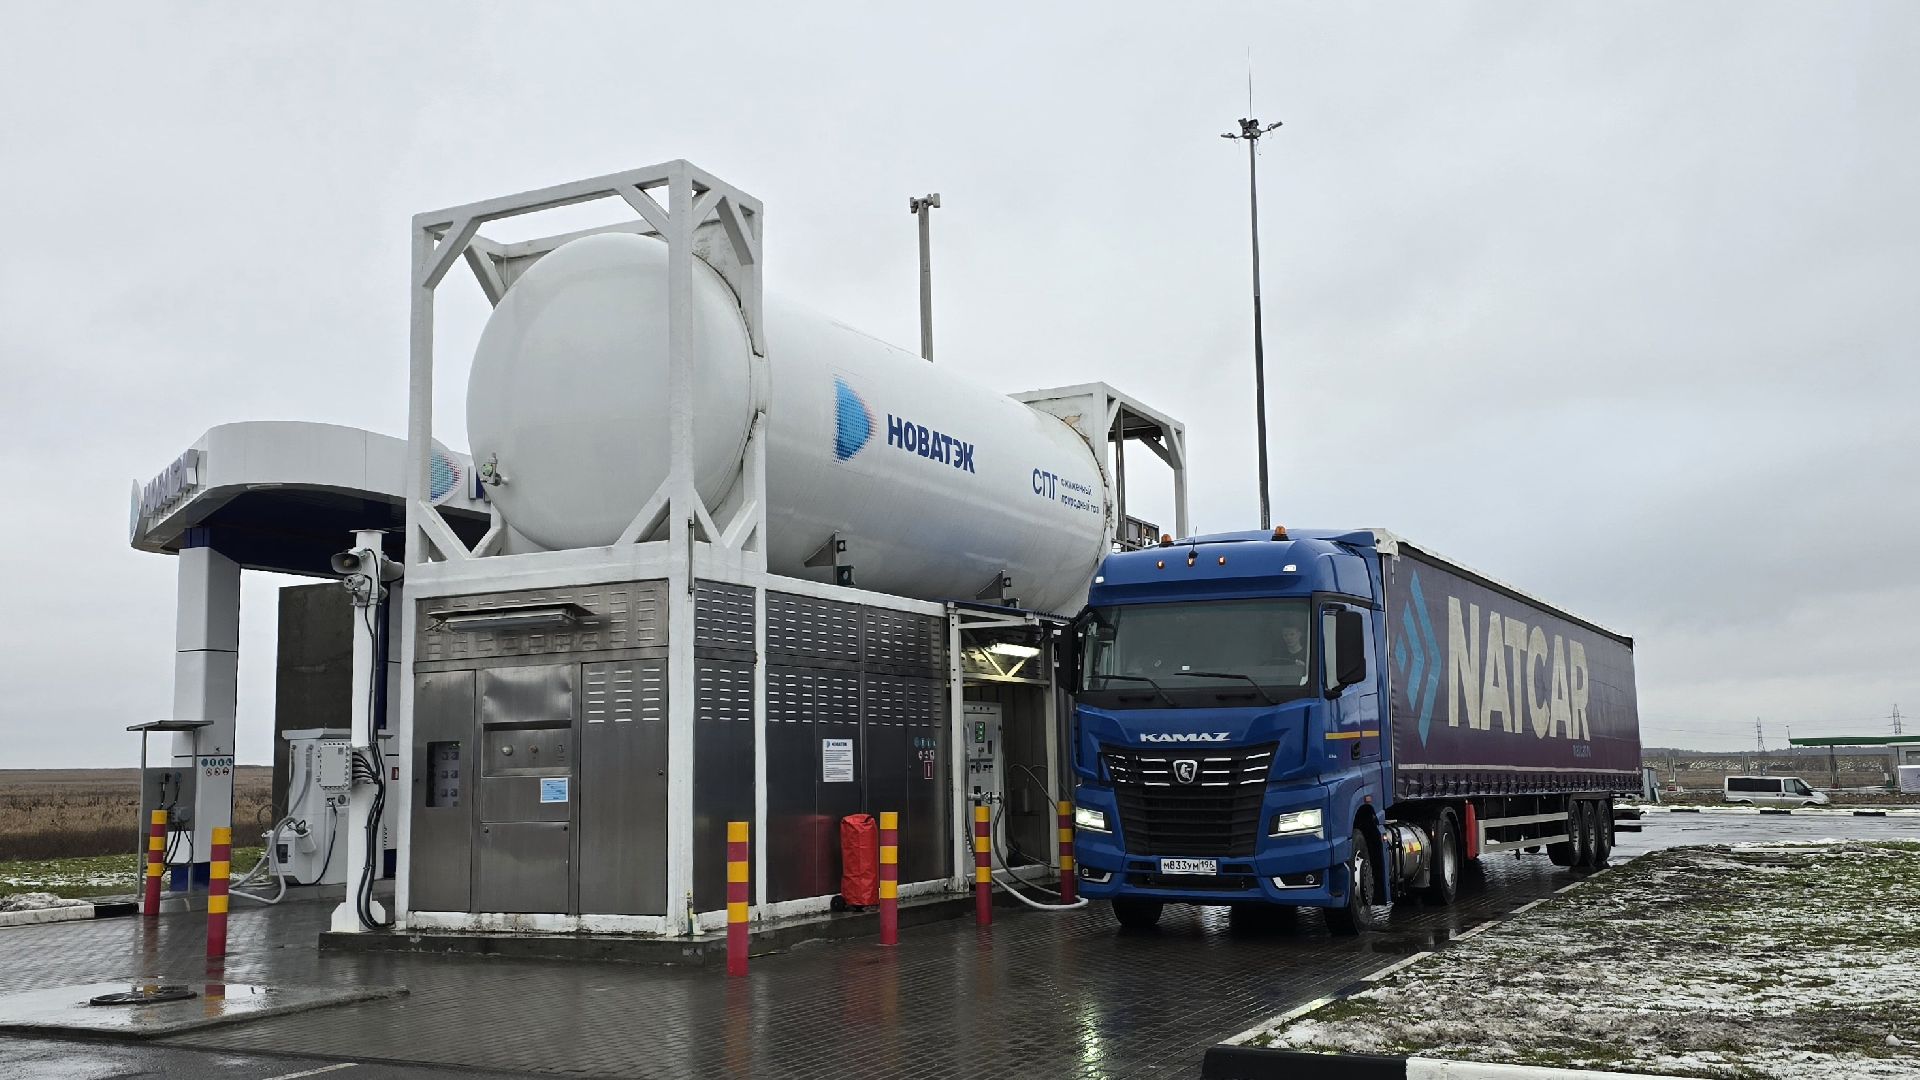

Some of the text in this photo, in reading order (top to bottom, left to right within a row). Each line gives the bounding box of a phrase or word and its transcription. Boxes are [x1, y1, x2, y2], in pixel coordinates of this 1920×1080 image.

[887, 413, 975, 474] НОВАТЭК
[1032, 468, 1058, 500] СПГ
[1448, 595, 1591, 742] NATCAR
[1140, 732, 1231, 742] KAMAZ
